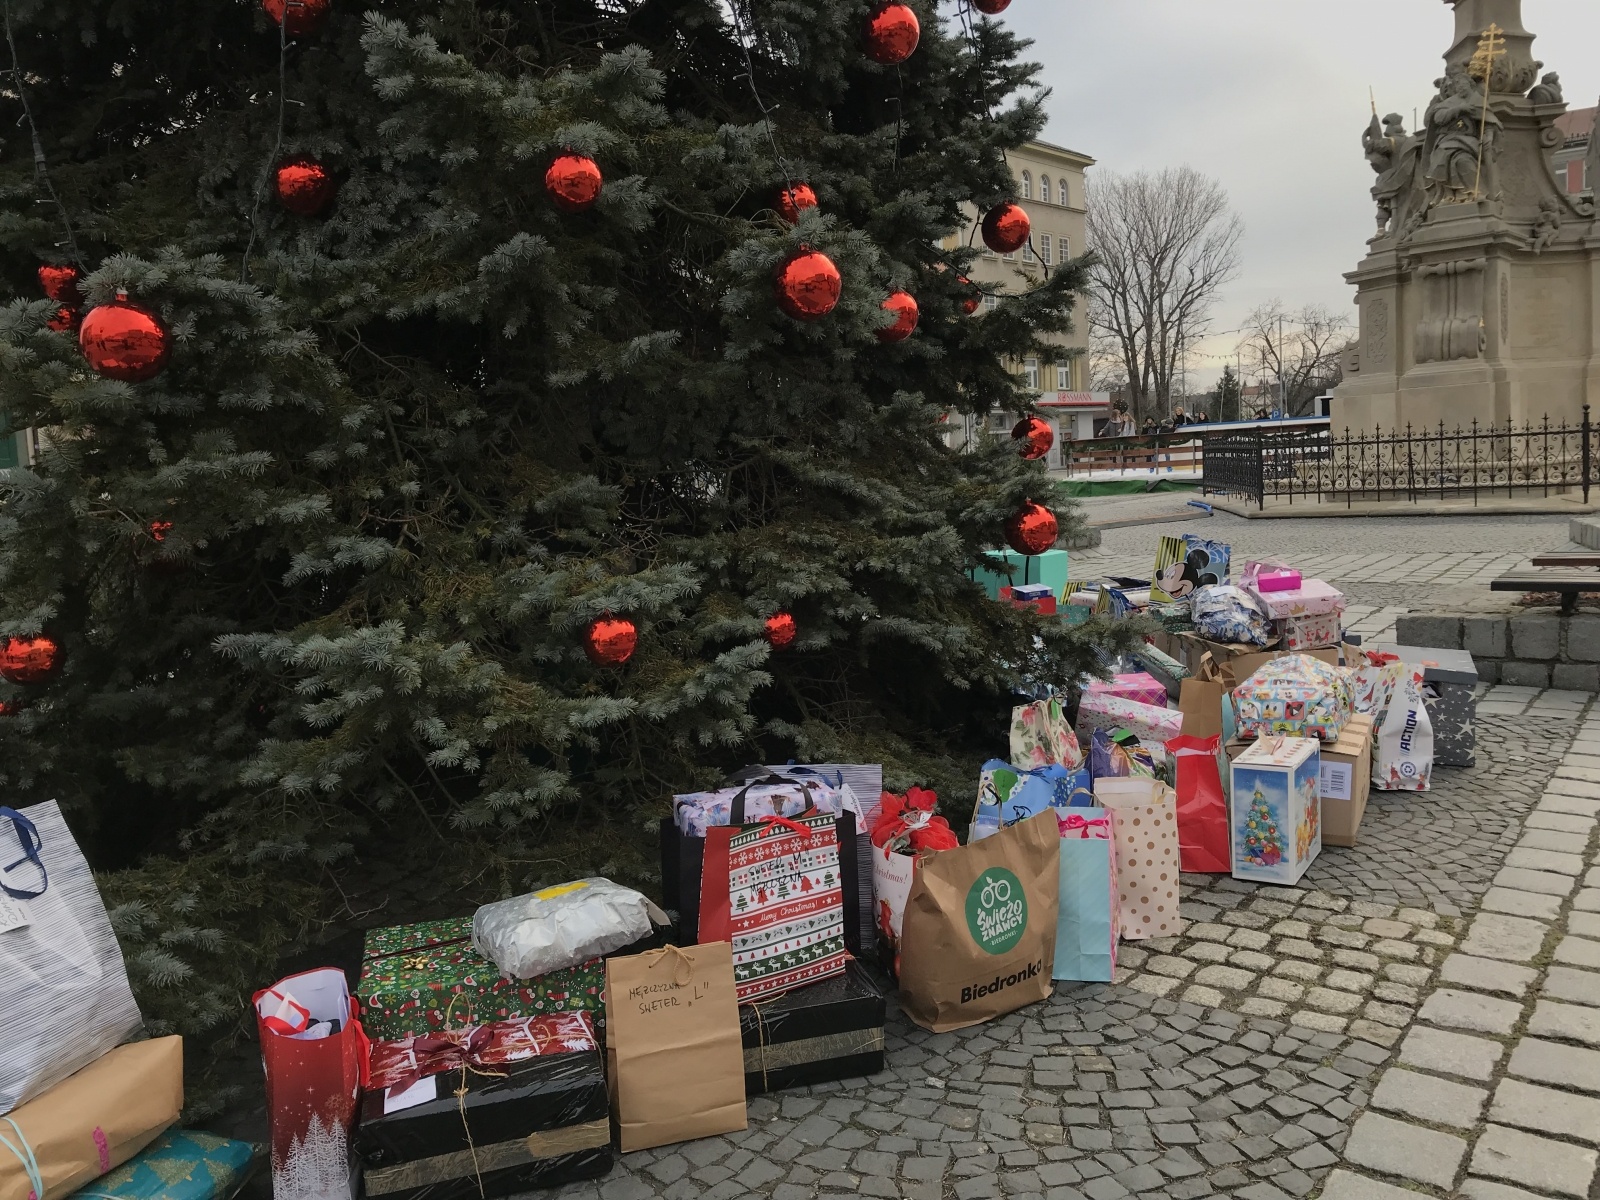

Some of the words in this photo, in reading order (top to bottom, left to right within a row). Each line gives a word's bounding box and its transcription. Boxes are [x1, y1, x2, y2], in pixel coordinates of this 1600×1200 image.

[1057, 392, 1092, 402] ROSSMANN
[1400, 709, 1418, 752] ACTION
[981, 913, 1023, 942] ZNAWCY
[960, 958, 1042, 1004] Biedronka
[639, 996, 681, 1015] SWETER
